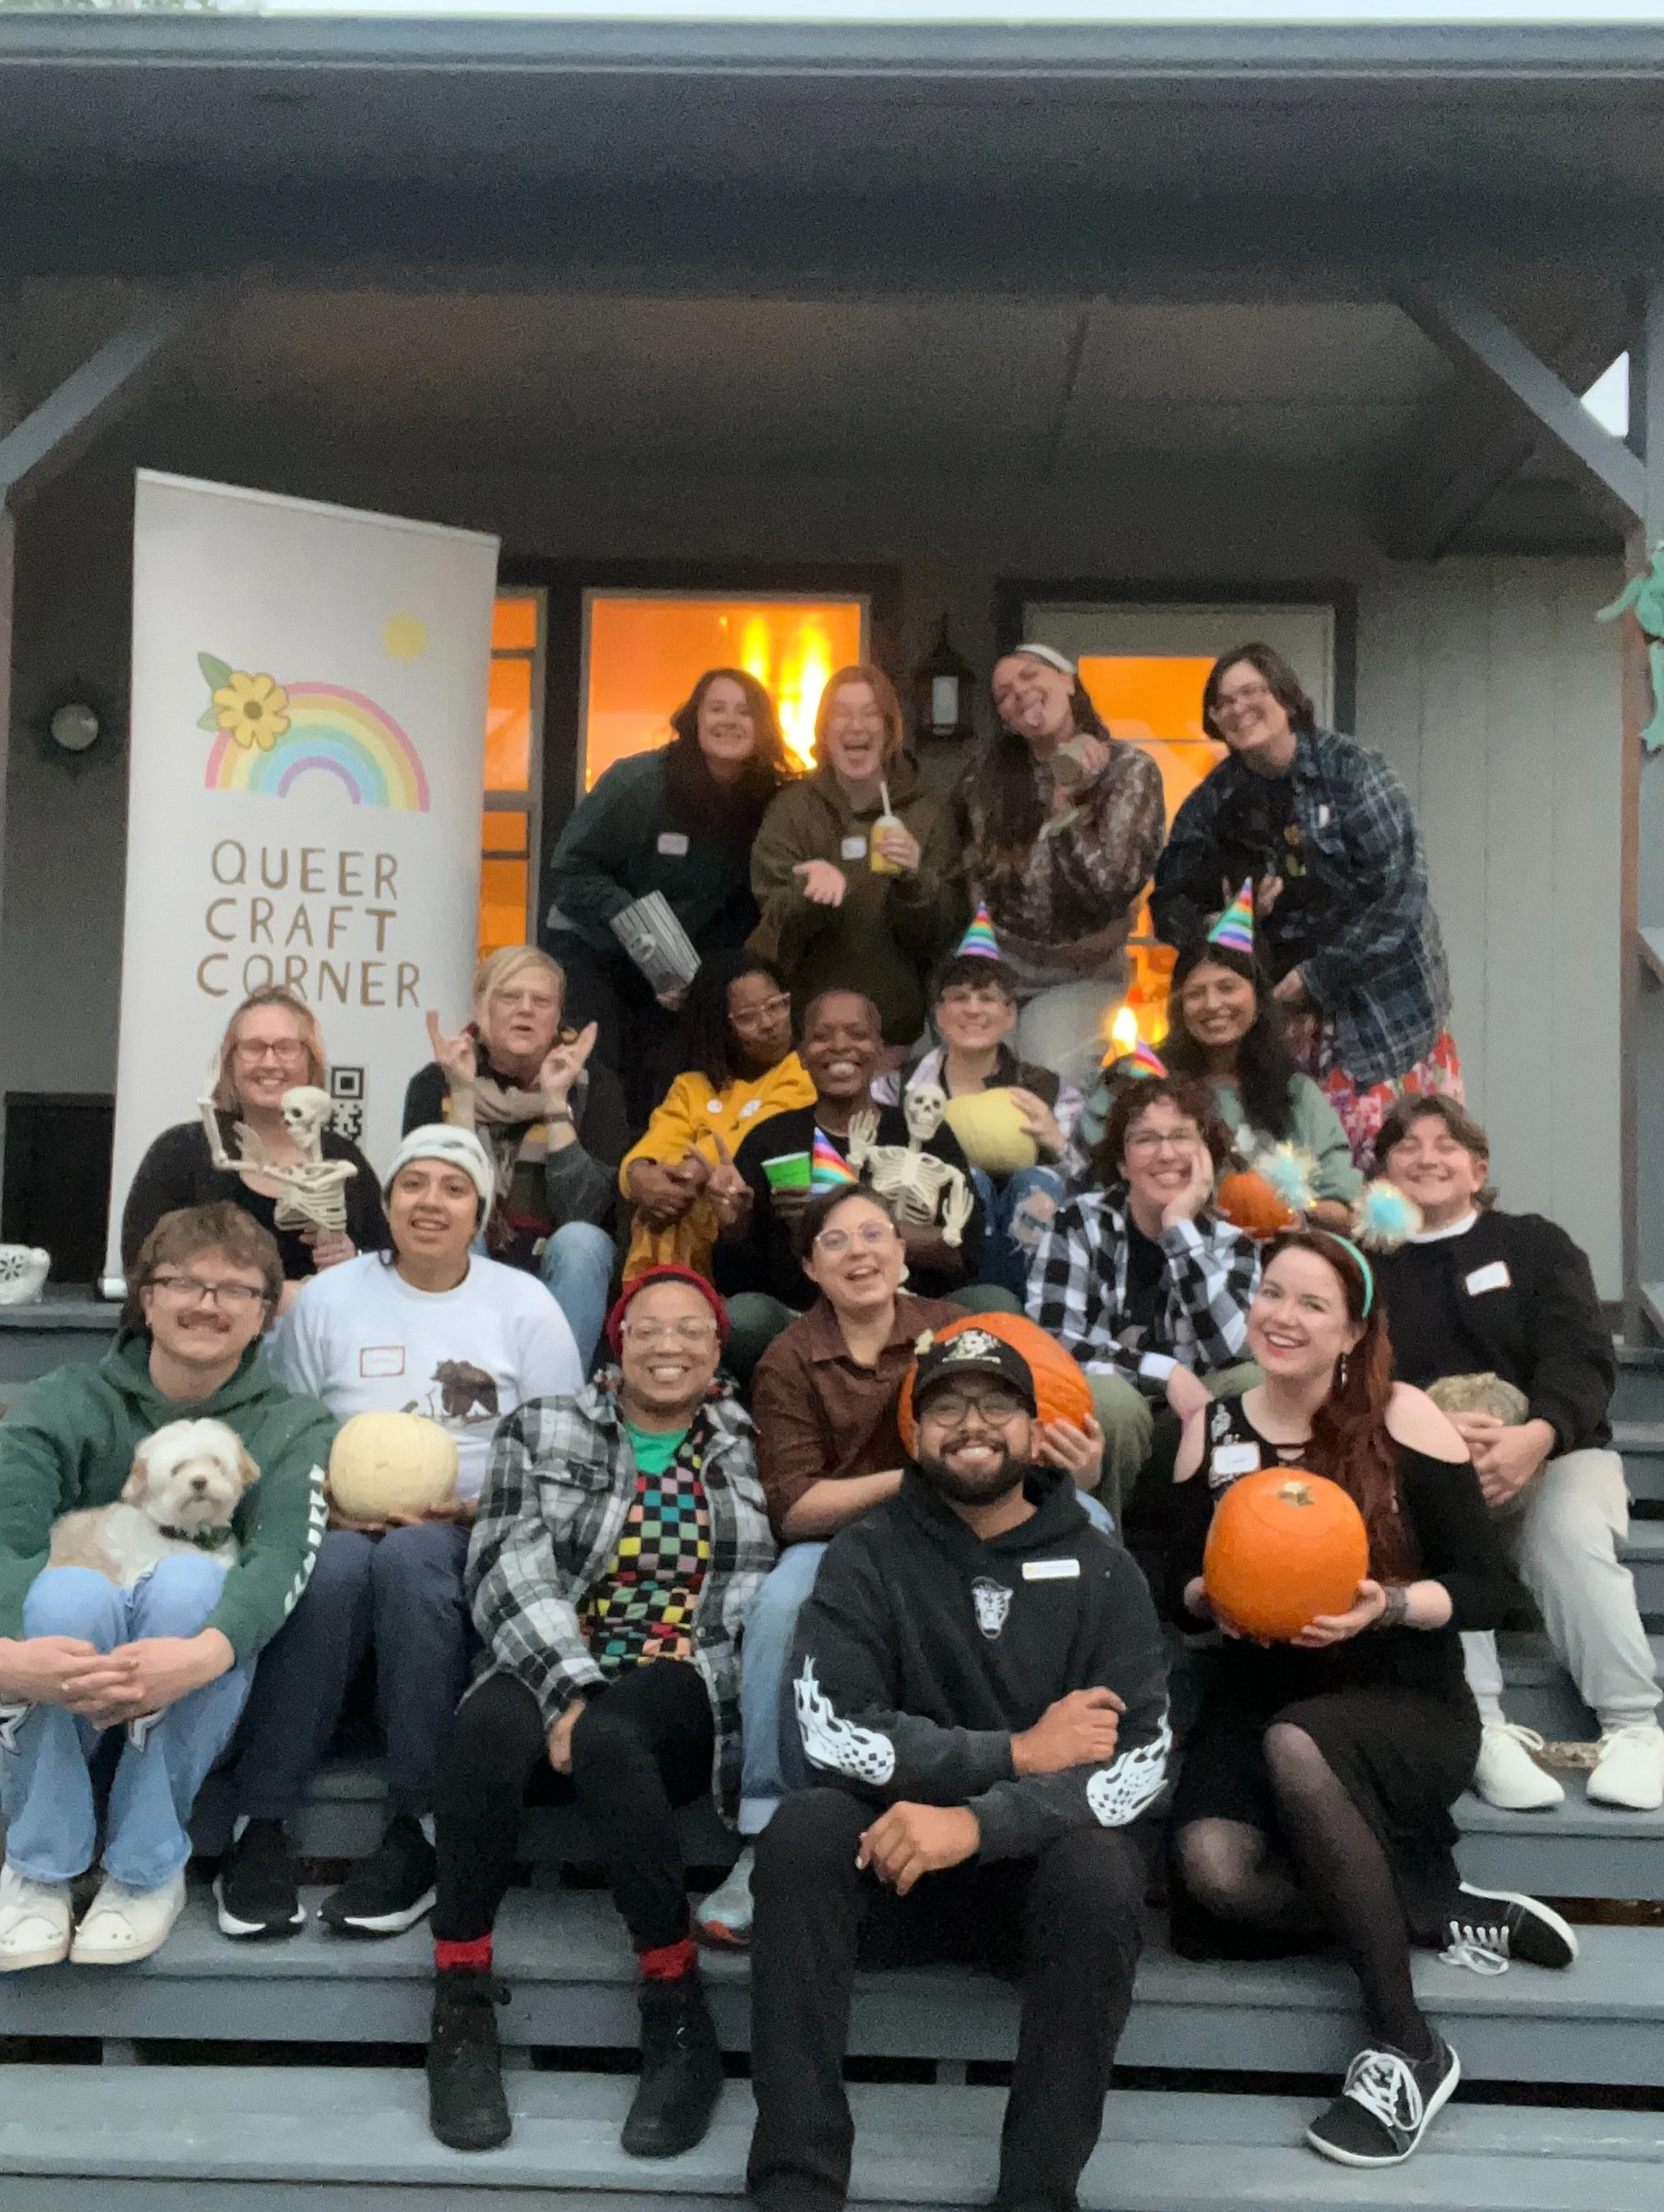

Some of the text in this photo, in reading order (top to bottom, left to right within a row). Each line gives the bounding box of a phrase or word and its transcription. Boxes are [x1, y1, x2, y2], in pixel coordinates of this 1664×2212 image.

[212, 839, 398, 899] QUEER
[205, 897, 397, 952] CRAFT
[197, 953, 420, 1007] CORNER
